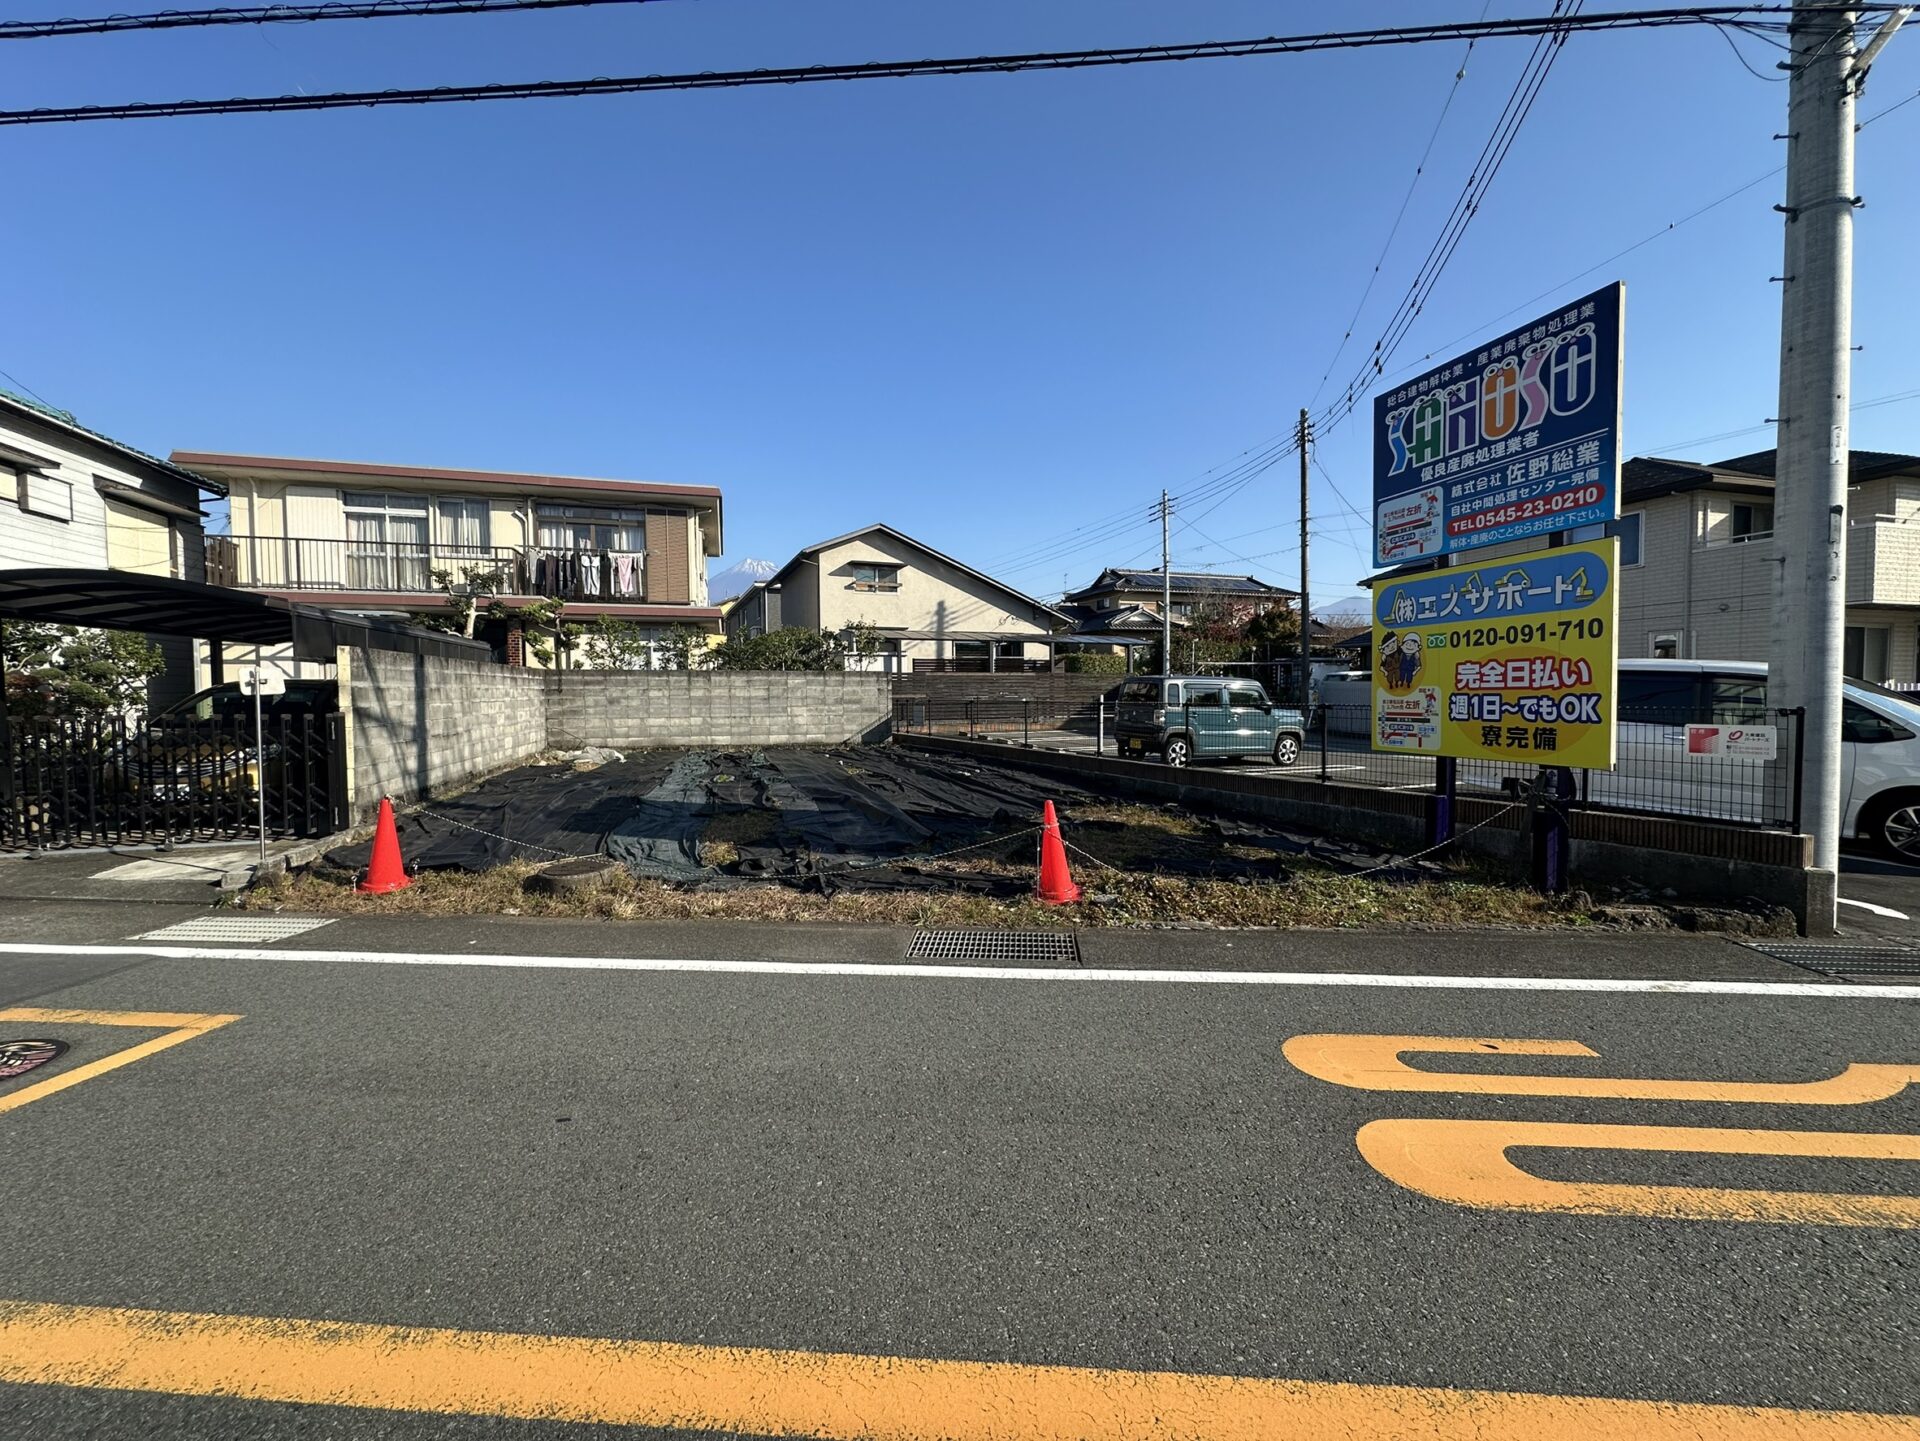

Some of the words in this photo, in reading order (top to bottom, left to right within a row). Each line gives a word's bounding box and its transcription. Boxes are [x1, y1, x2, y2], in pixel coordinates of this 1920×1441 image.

[1386, 301, 1596, 408] 総合建物解体業・産業廃棄物処理業
[1420, 430, 1541, 483] 優良産廃処理業者
[1450, 472, 1502, 499] 株式会社
[1506, 440, 1601, 486] 佐野総業
[1450, 467, 1600, 517] 自社中間処理センター完備
[1448, 507, 1607, 549] 解体・産廃のことならお任せ下さい。
[1449, 617, 1604, 649] 0120-091-710
[1456, 657, 1591, 691] 完全日払い
[1481, 725, 1558, 751] 寮完備
